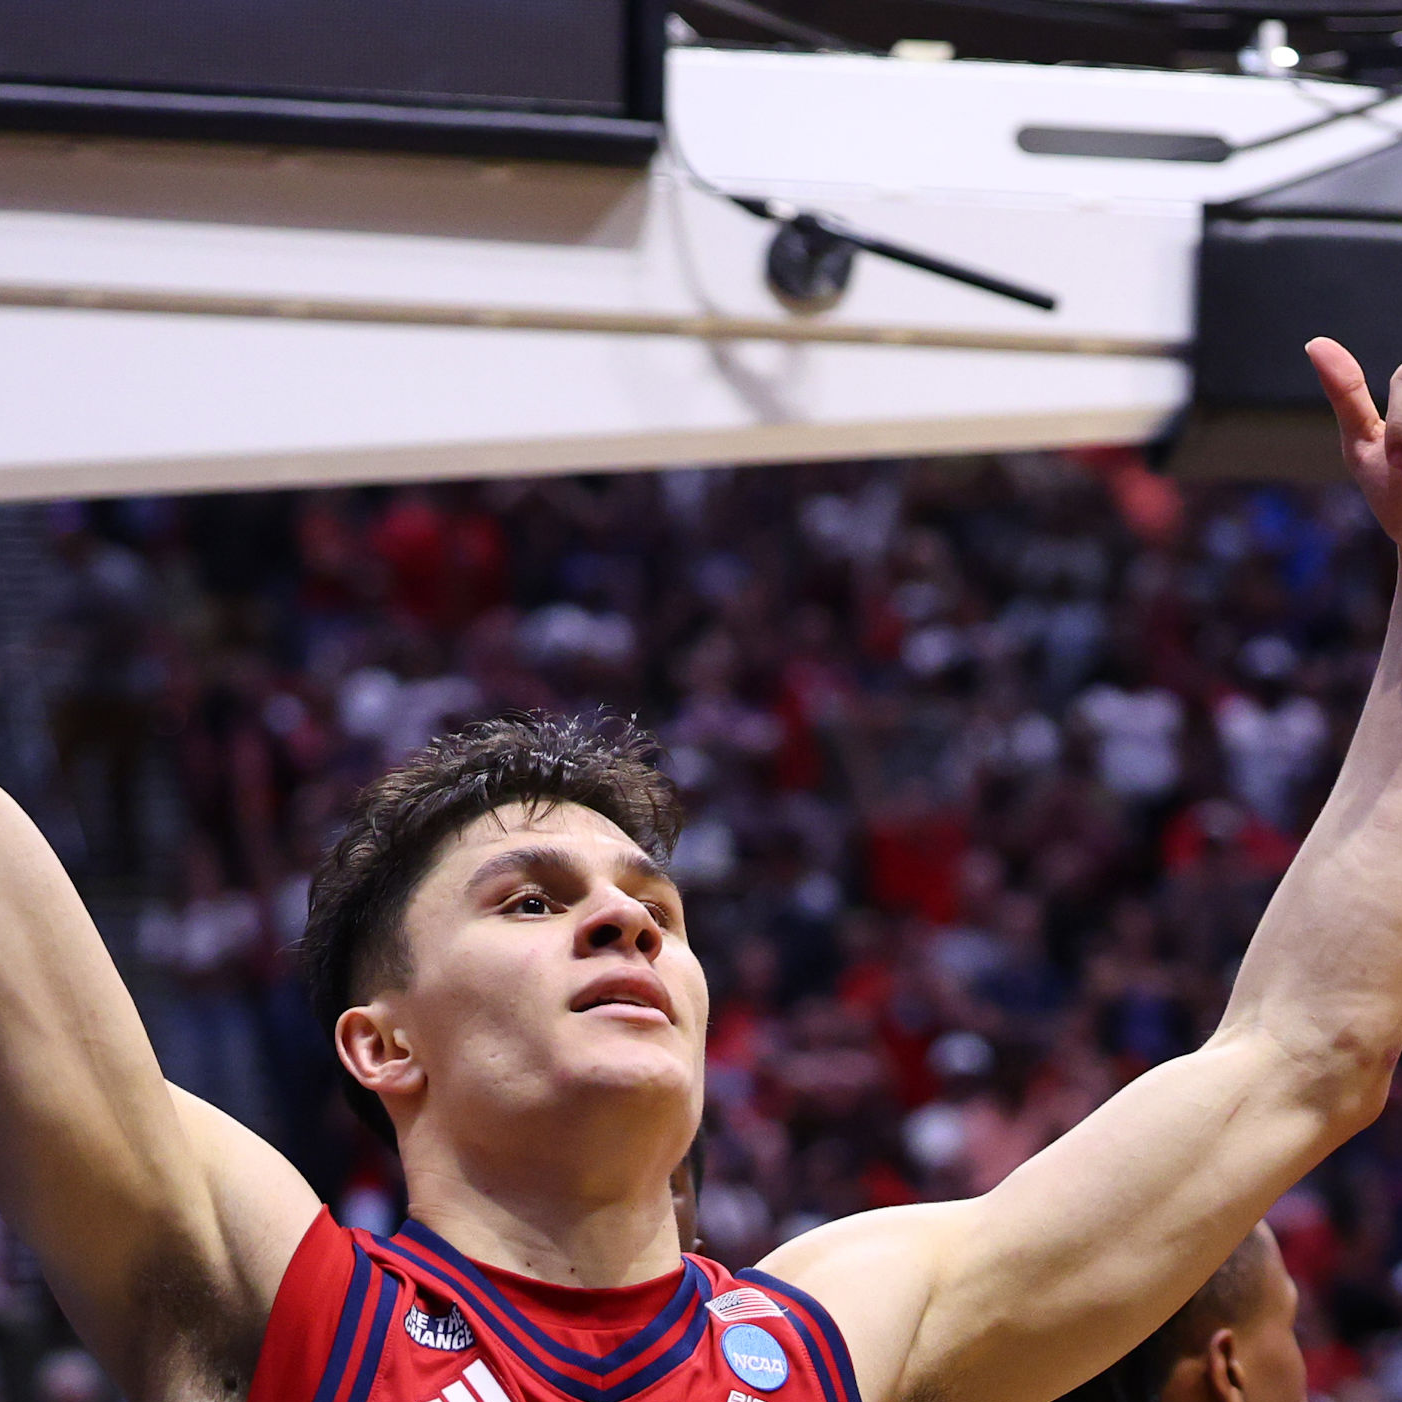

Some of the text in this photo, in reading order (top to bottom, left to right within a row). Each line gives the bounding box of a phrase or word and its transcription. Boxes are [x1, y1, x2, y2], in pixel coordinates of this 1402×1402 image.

[404, 1313, 474, 1351] CHANGE
[410, 1304, 464, 1333] BE THE
[732, 1351, 785, 1375] NCAA
